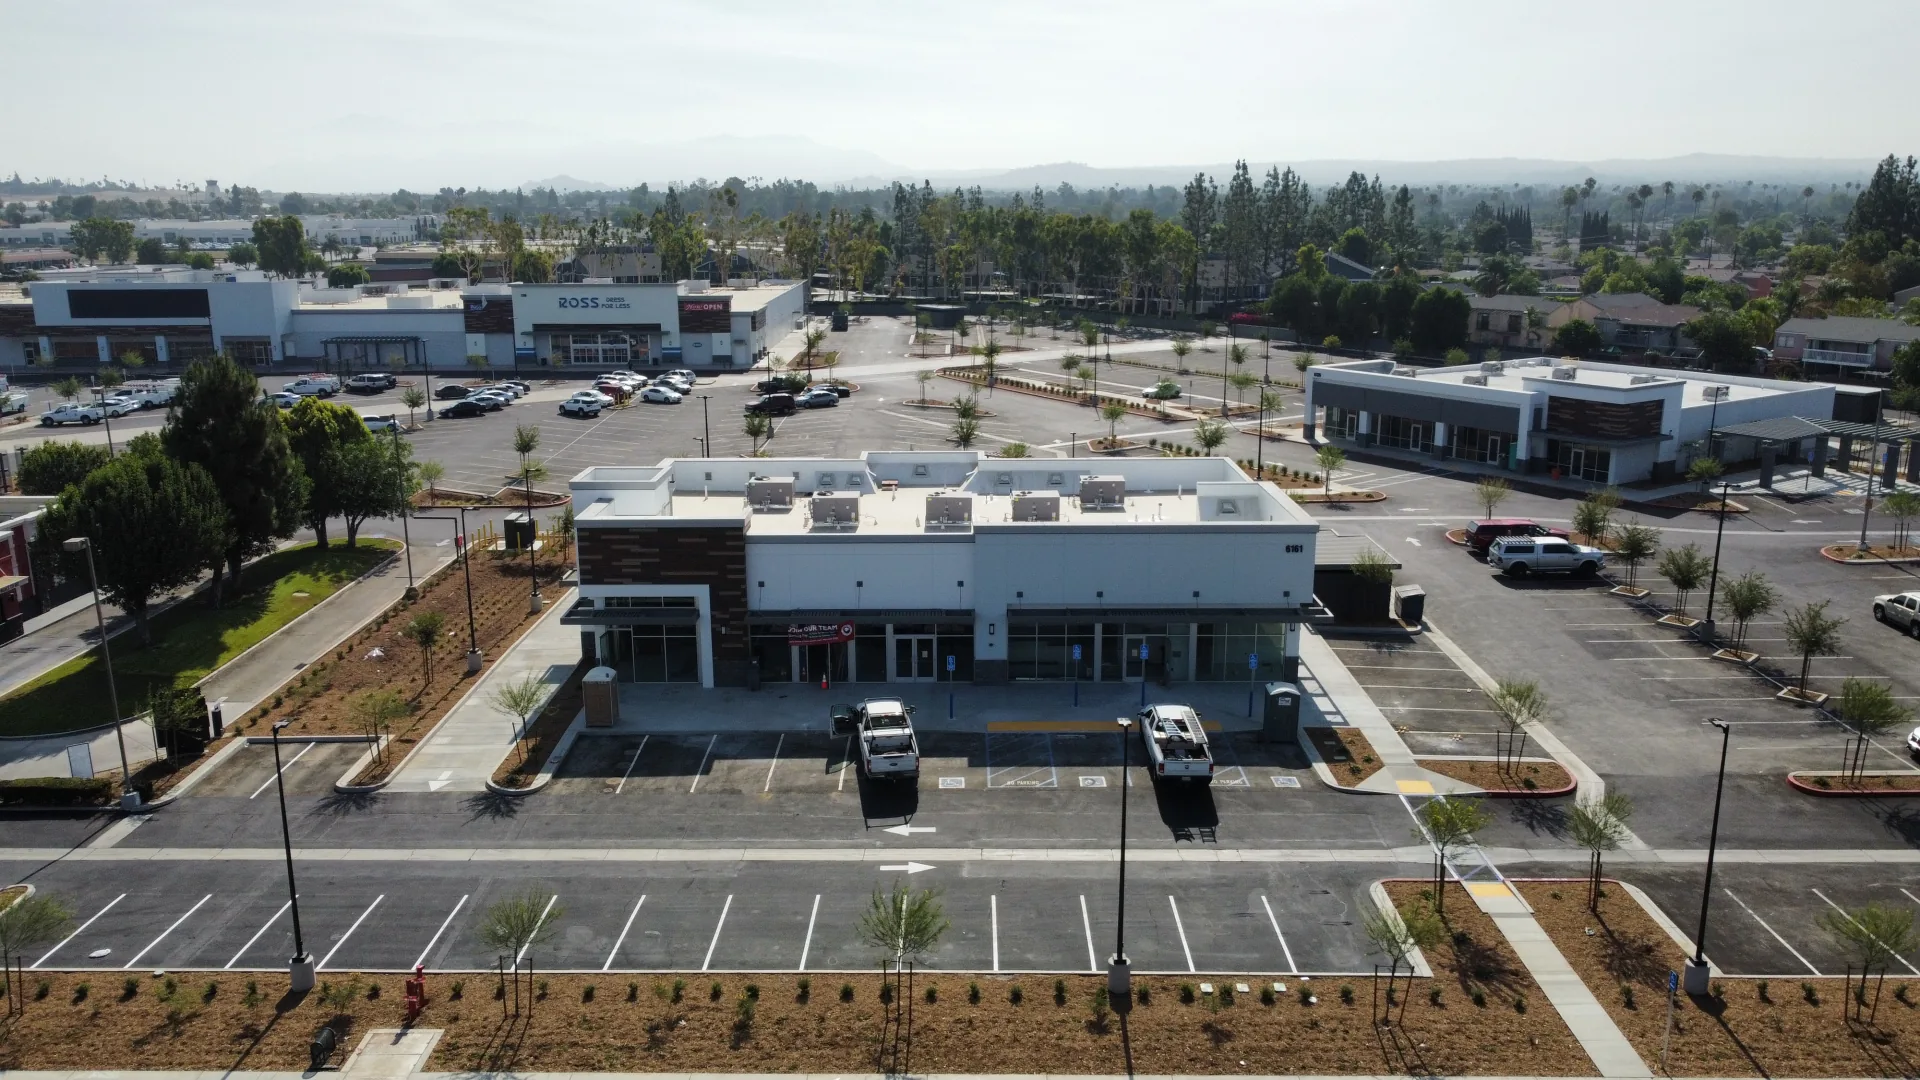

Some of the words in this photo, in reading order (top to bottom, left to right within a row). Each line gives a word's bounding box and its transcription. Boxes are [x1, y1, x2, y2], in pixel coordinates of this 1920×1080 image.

[558, 297, 599, 309] ROSS
[703, 303, 723, 311] OPEN
[1285, 545, 1303, 553] 6161
